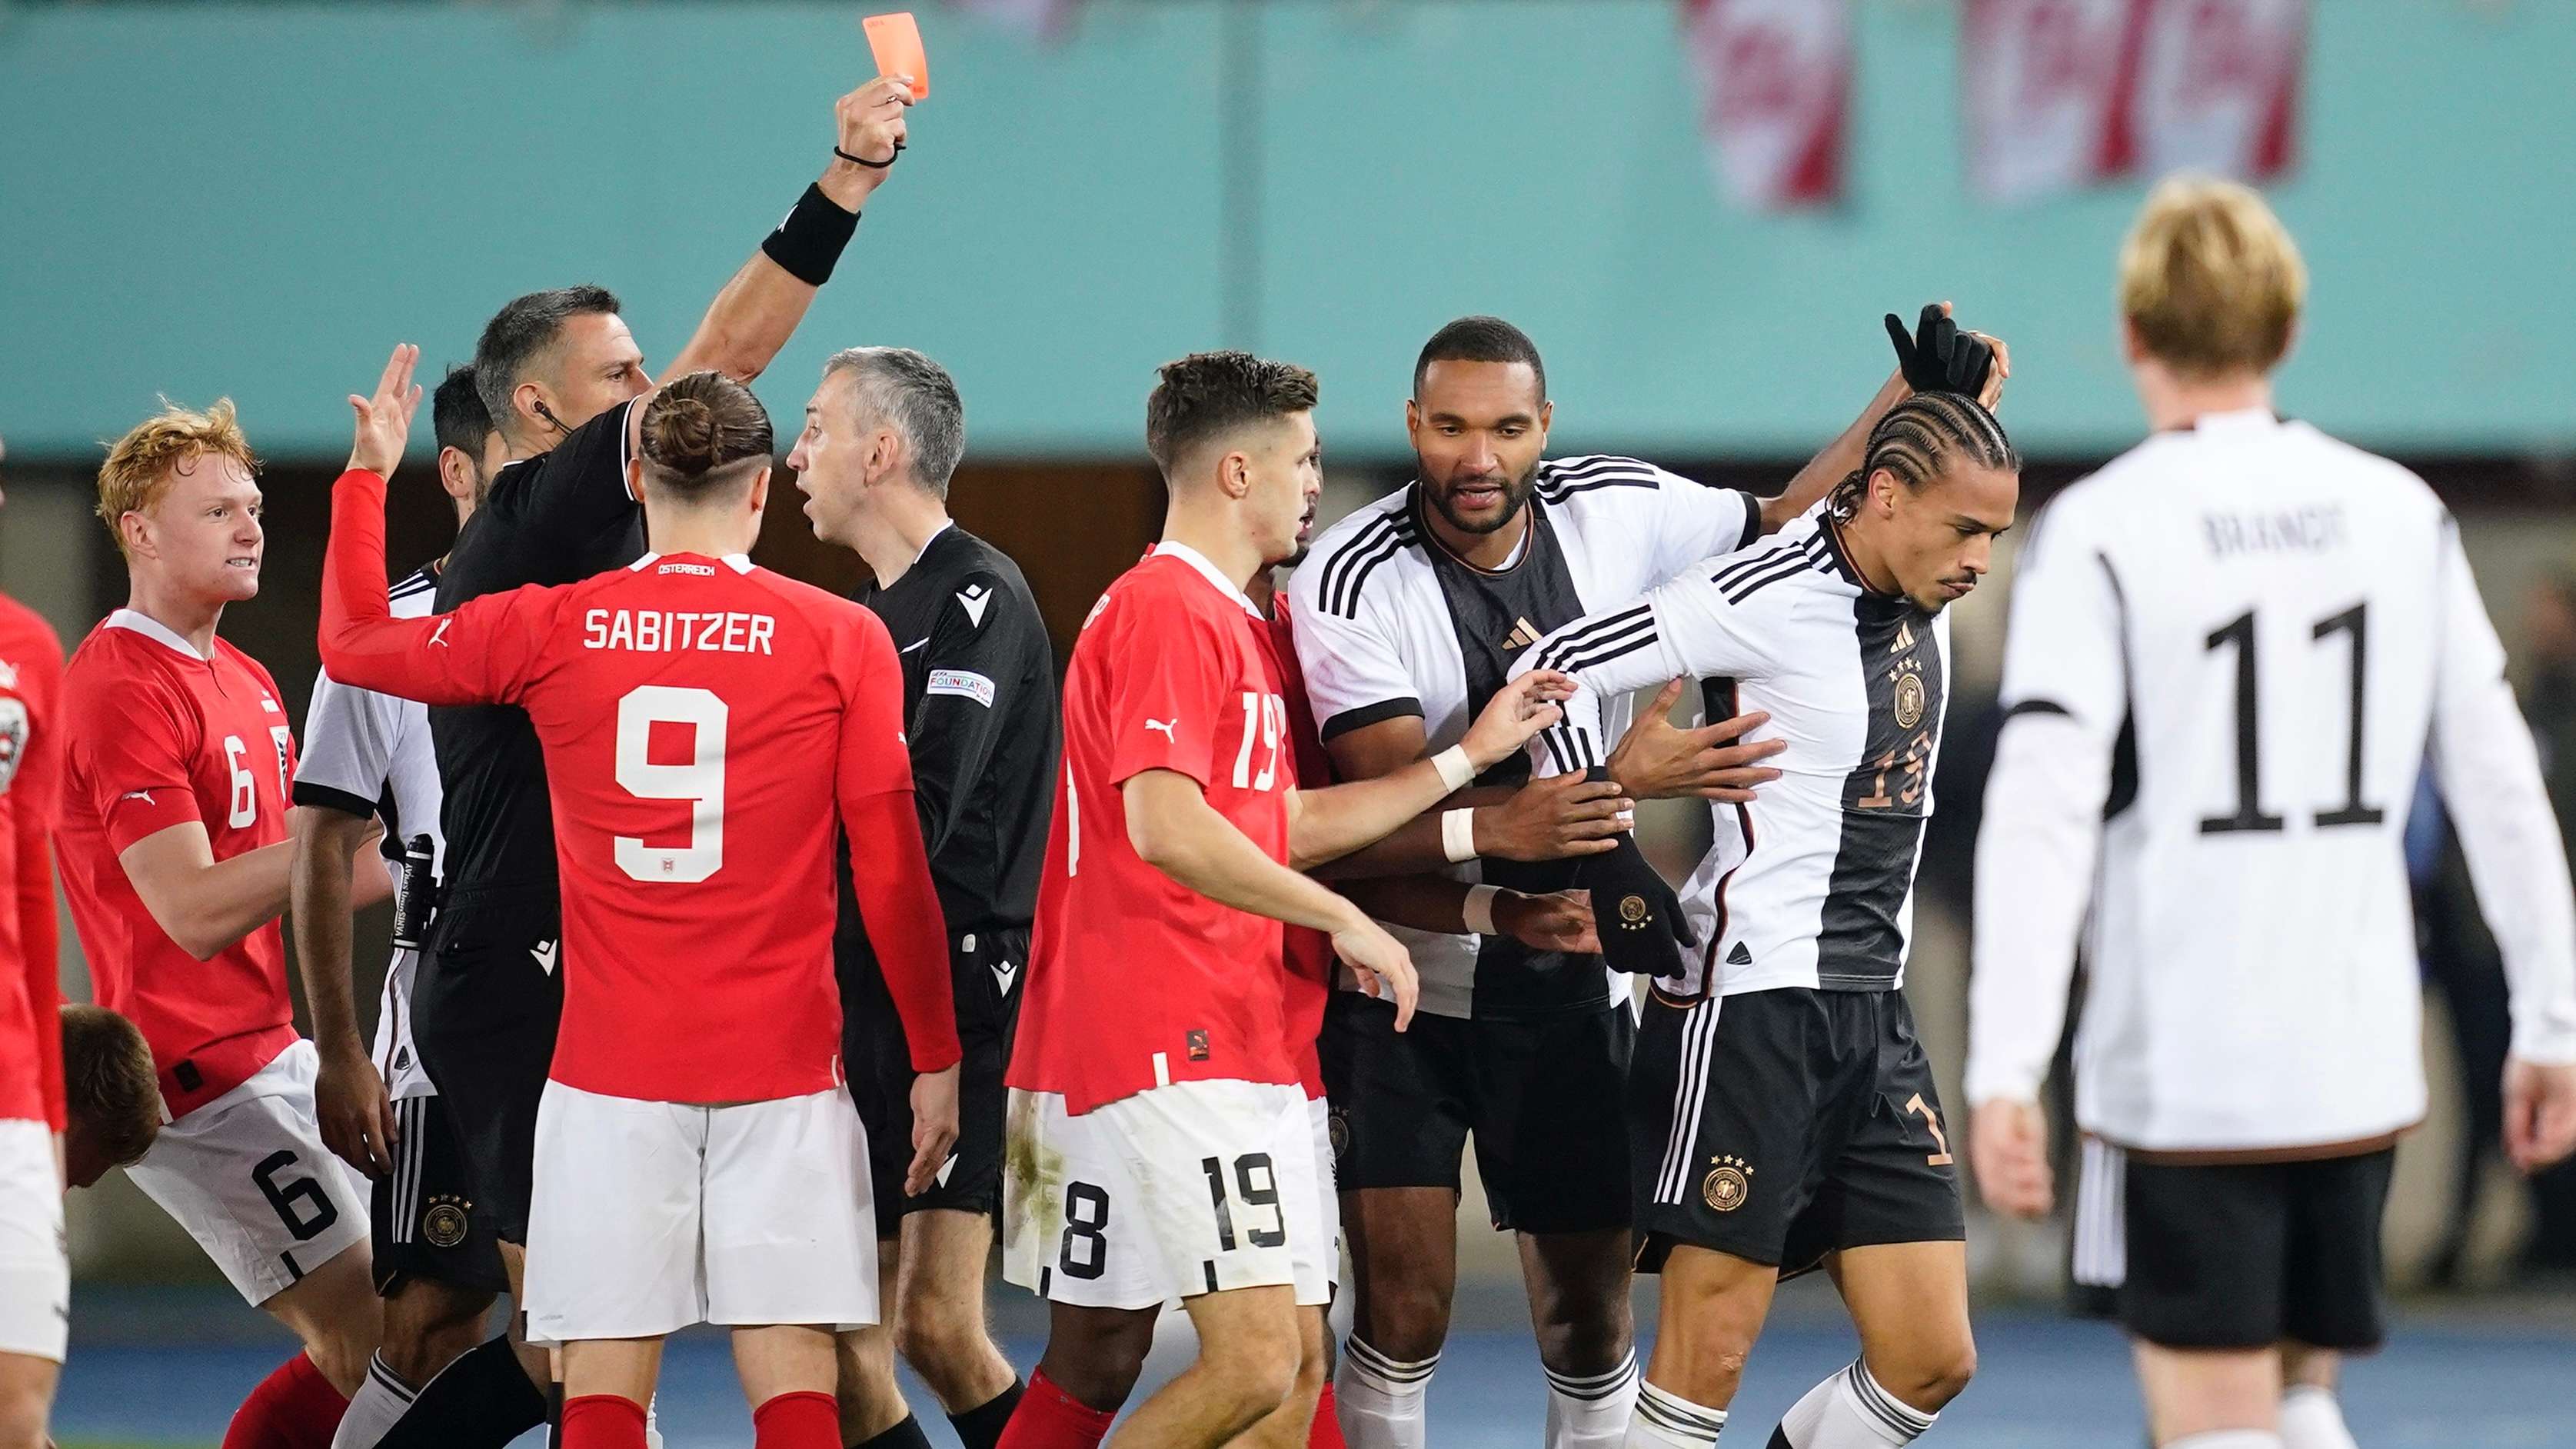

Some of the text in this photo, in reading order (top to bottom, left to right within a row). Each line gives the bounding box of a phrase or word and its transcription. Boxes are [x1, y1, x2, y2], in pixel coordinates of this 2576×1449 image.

[584, 608, 775, 655] SABITZER
[930, 677, 993, 700] FOUNDATION
[2201, 604, 2383, 833] 11
[224, 734, 257, 829] 6
[614, 685, 728, 883] 9
[1232, 691, 1277, 792] 19
[1858, 730, 1932, 808] 19
[251, 1149, 338, 1241] 6
[1059, 1181, 1110, 1281] 8
[1202, 1152, 1286, 1251] 19
